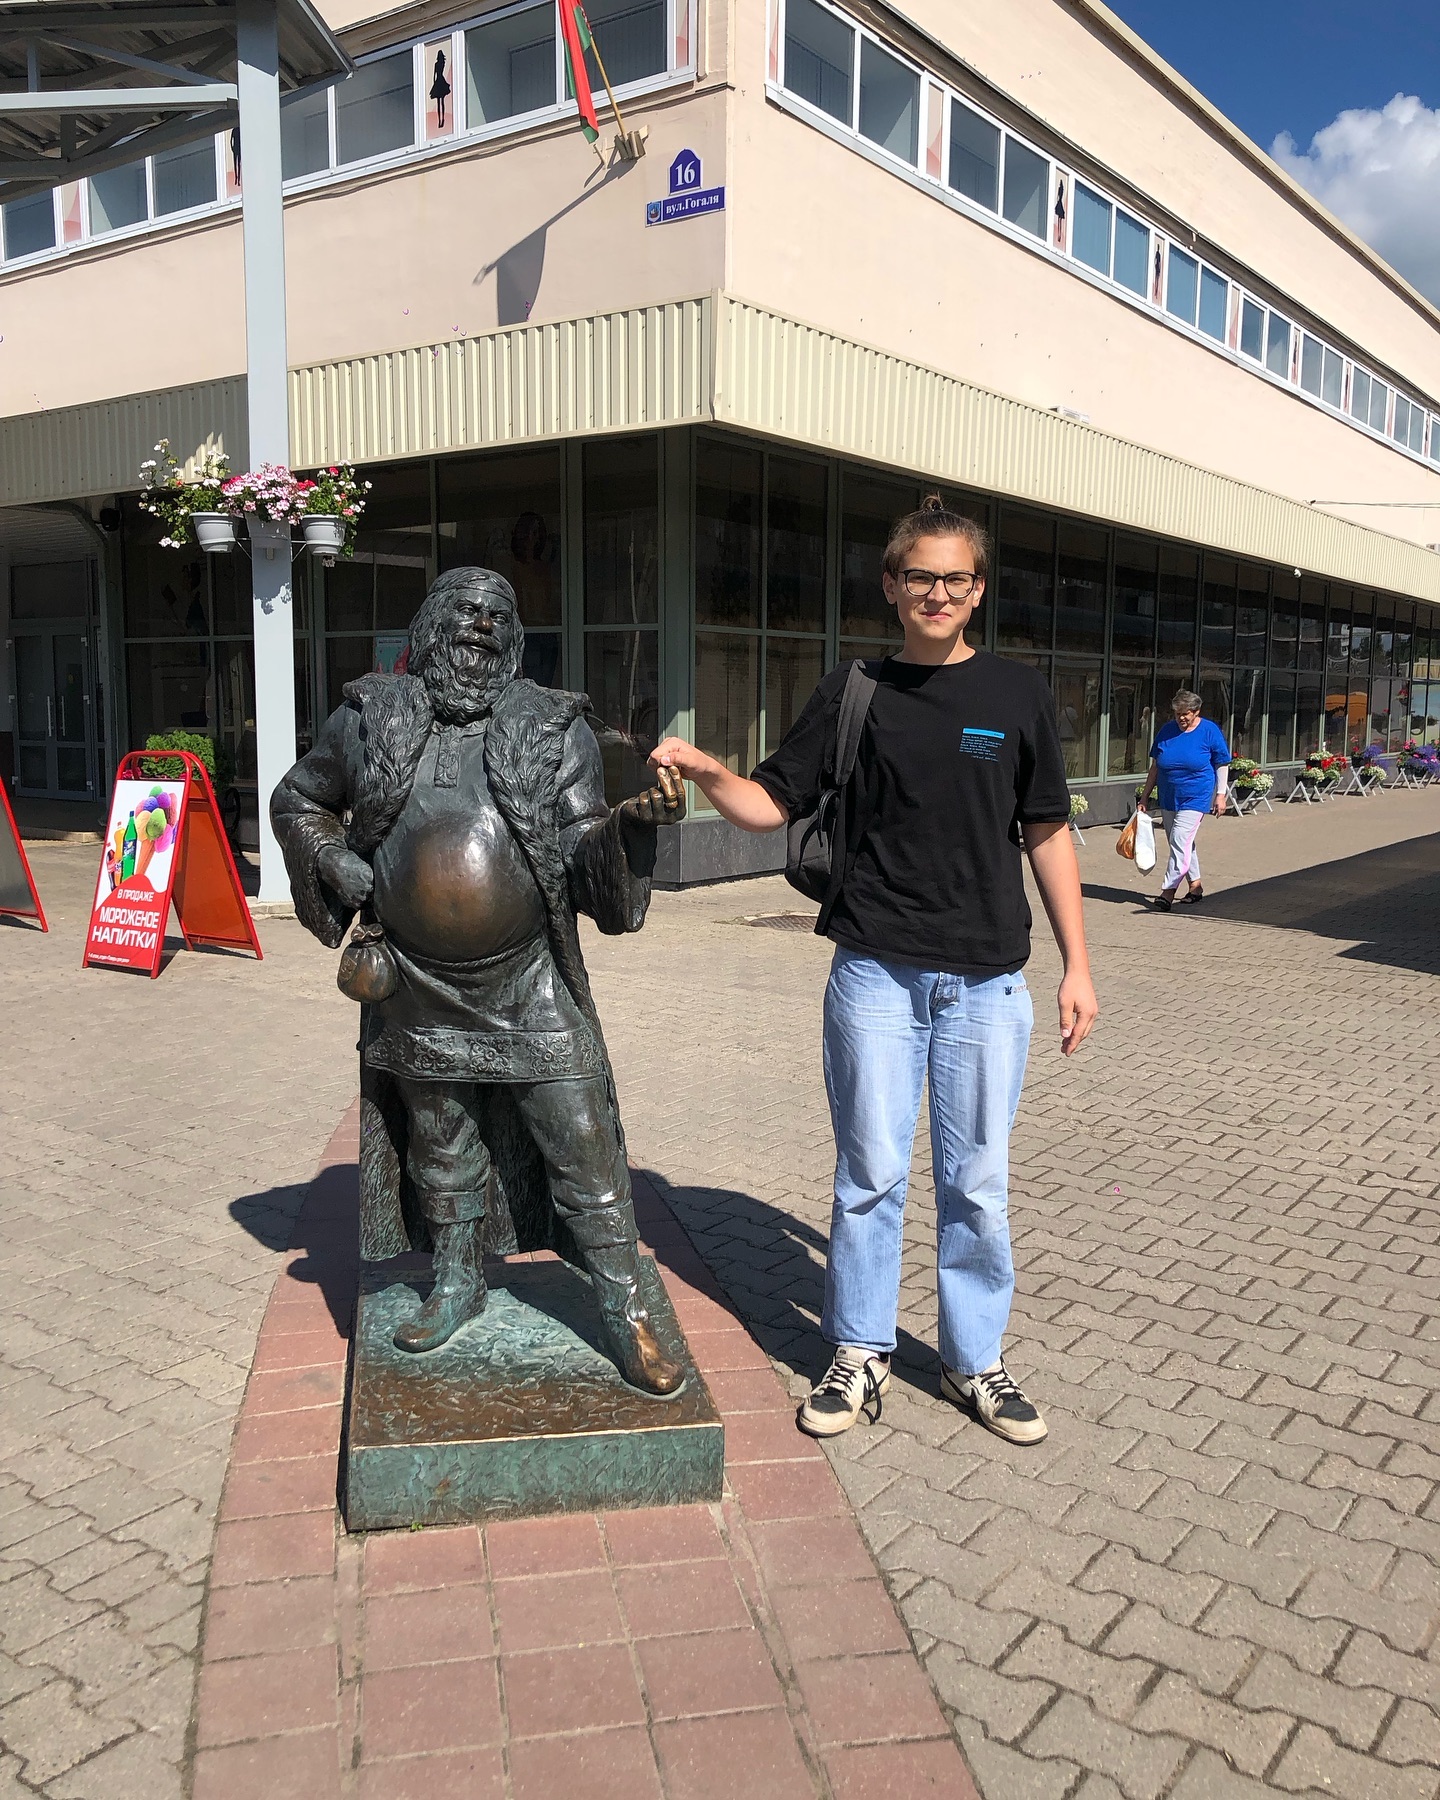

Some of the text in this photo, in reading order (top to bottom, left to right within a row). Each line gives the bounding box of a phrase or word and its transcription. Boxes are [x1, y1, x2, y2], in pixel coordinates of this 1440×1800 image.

[675, 160, 695, 186] 16
[666, 195, 719, 215] вул.Гогаля
[117, 889, 154, 902] В ПРОДАЖЕ
[99, 906, 160, 929] МОРОЖЕНОЕ
[91, 925, 157, 949] НАПИТКИ
